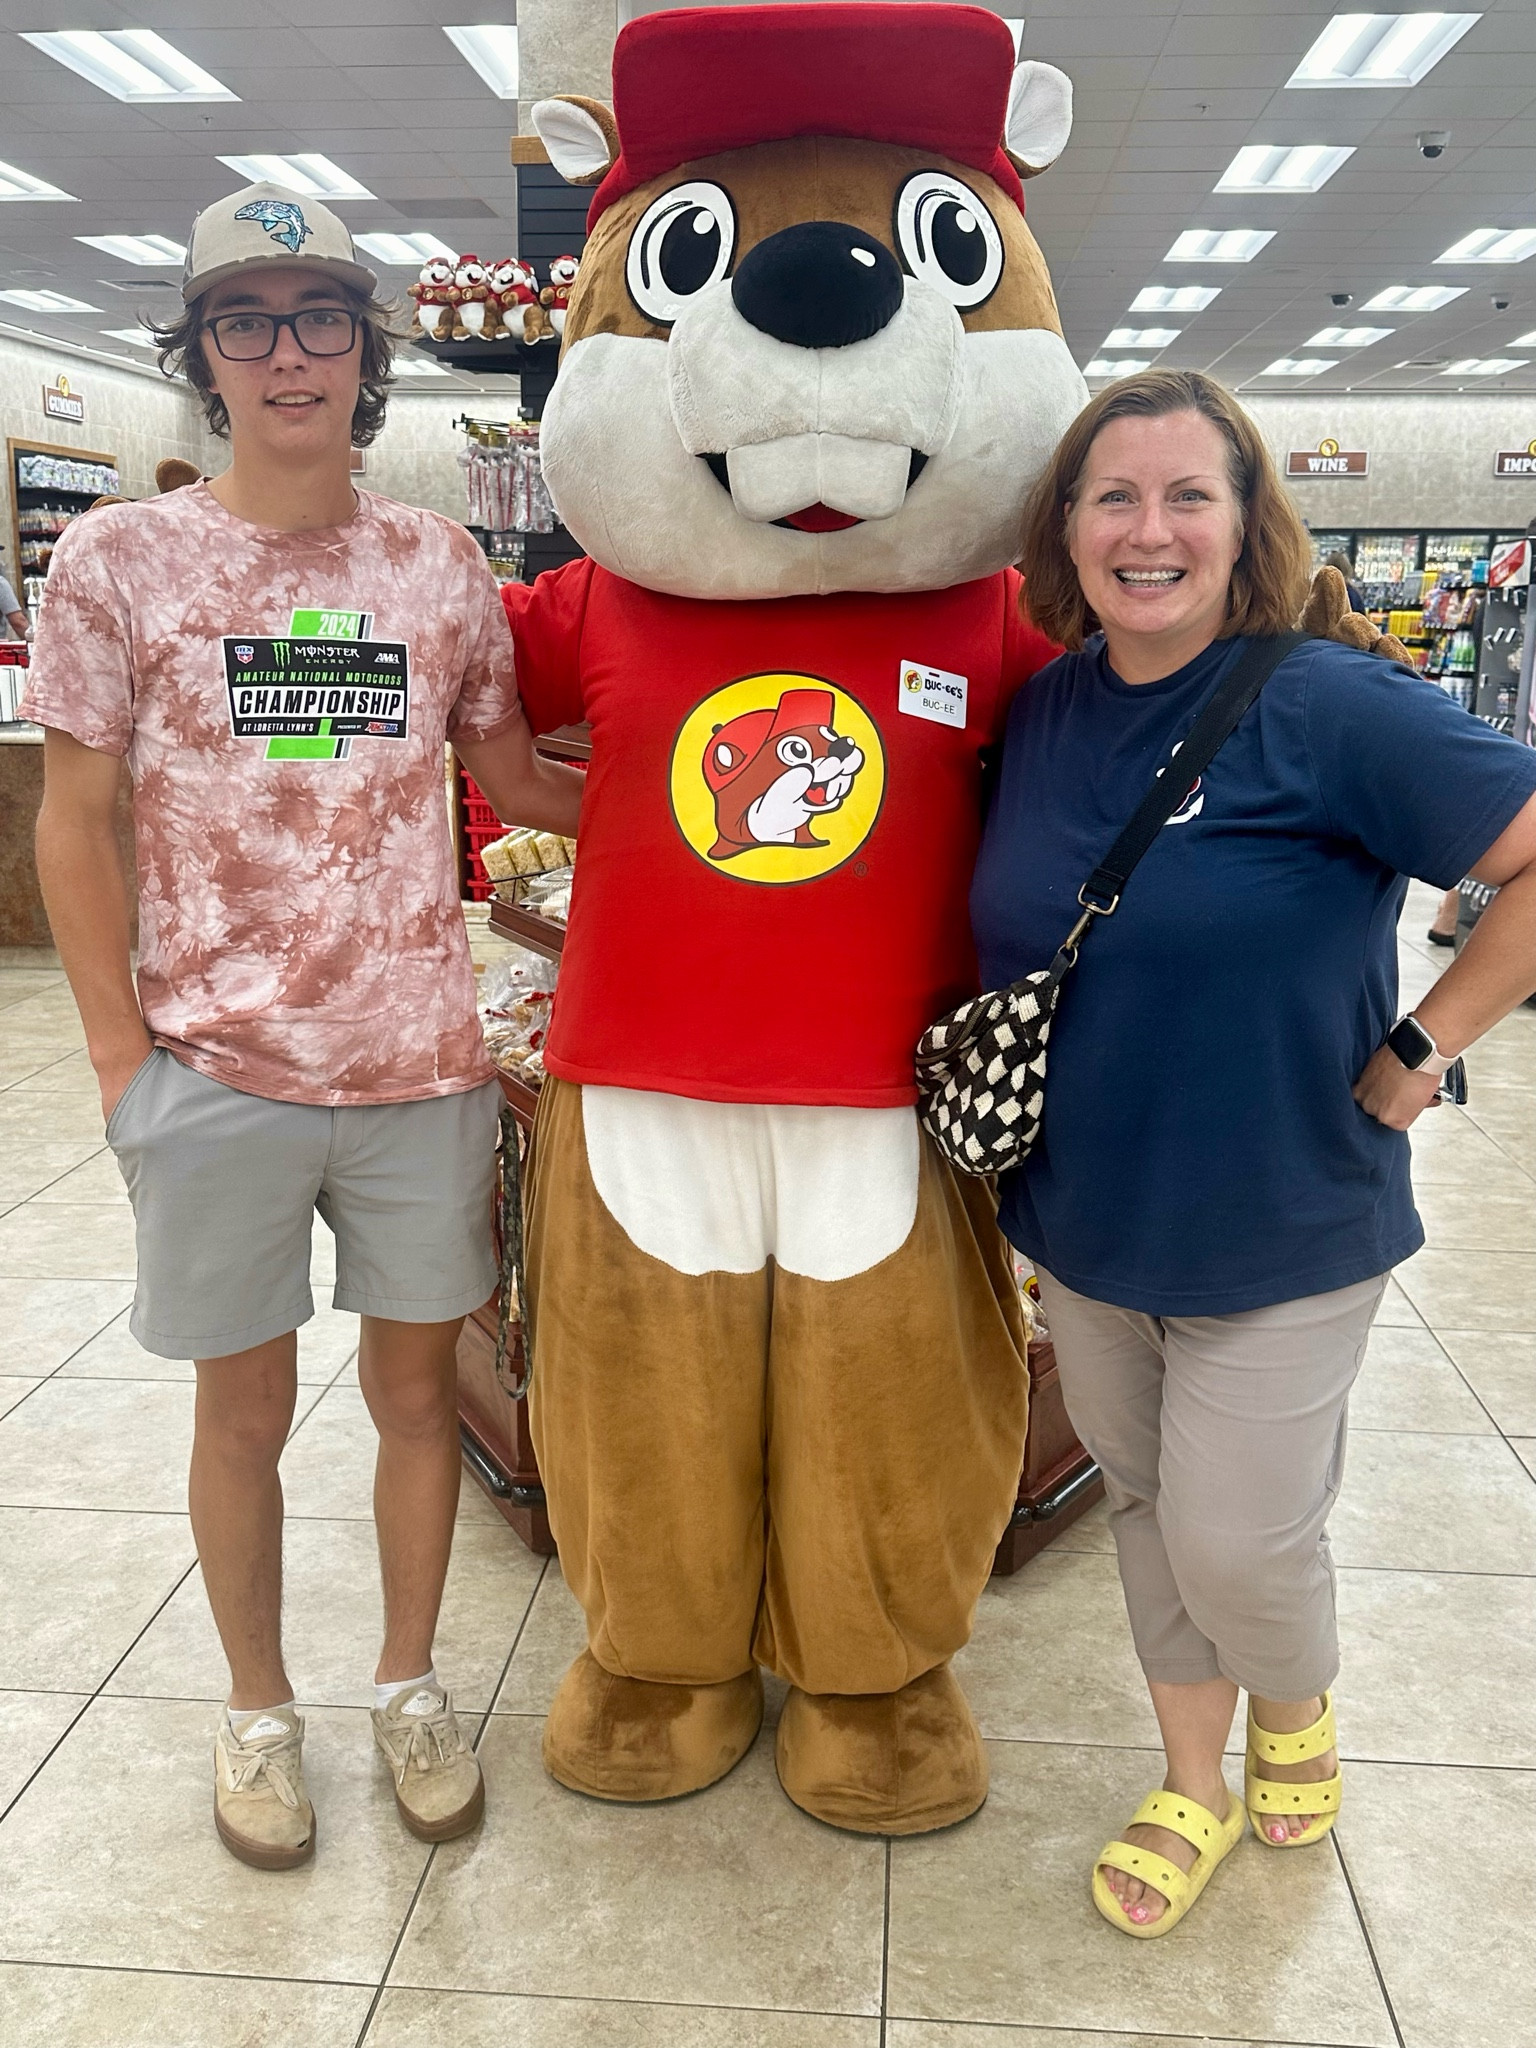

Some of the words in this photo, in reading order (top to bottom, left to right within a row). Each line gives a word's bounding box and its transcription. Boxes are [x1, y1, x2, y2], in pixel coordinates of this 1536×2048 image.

[1308, 458, 1348, 472] WINE
[318, 613, 357, 637] 2024
[374, 653, 400, 664] AMA
[235, 671, 285, 682] AMATEUR
[290, 671, 340, 682] NATIONAL
[346, 672, 402, 685] MOTOCROSS
[239, 690, 401, 715] CHAMPIONSHIP
[923, 698, 955, 714] BUC-EE
[242, 723, 252, 732] AT
[253, 722, 284, 732] LORETTA
[287, 722, 314, 732] LYNN'S
[366, 722, 398, 732] AMSOIL
